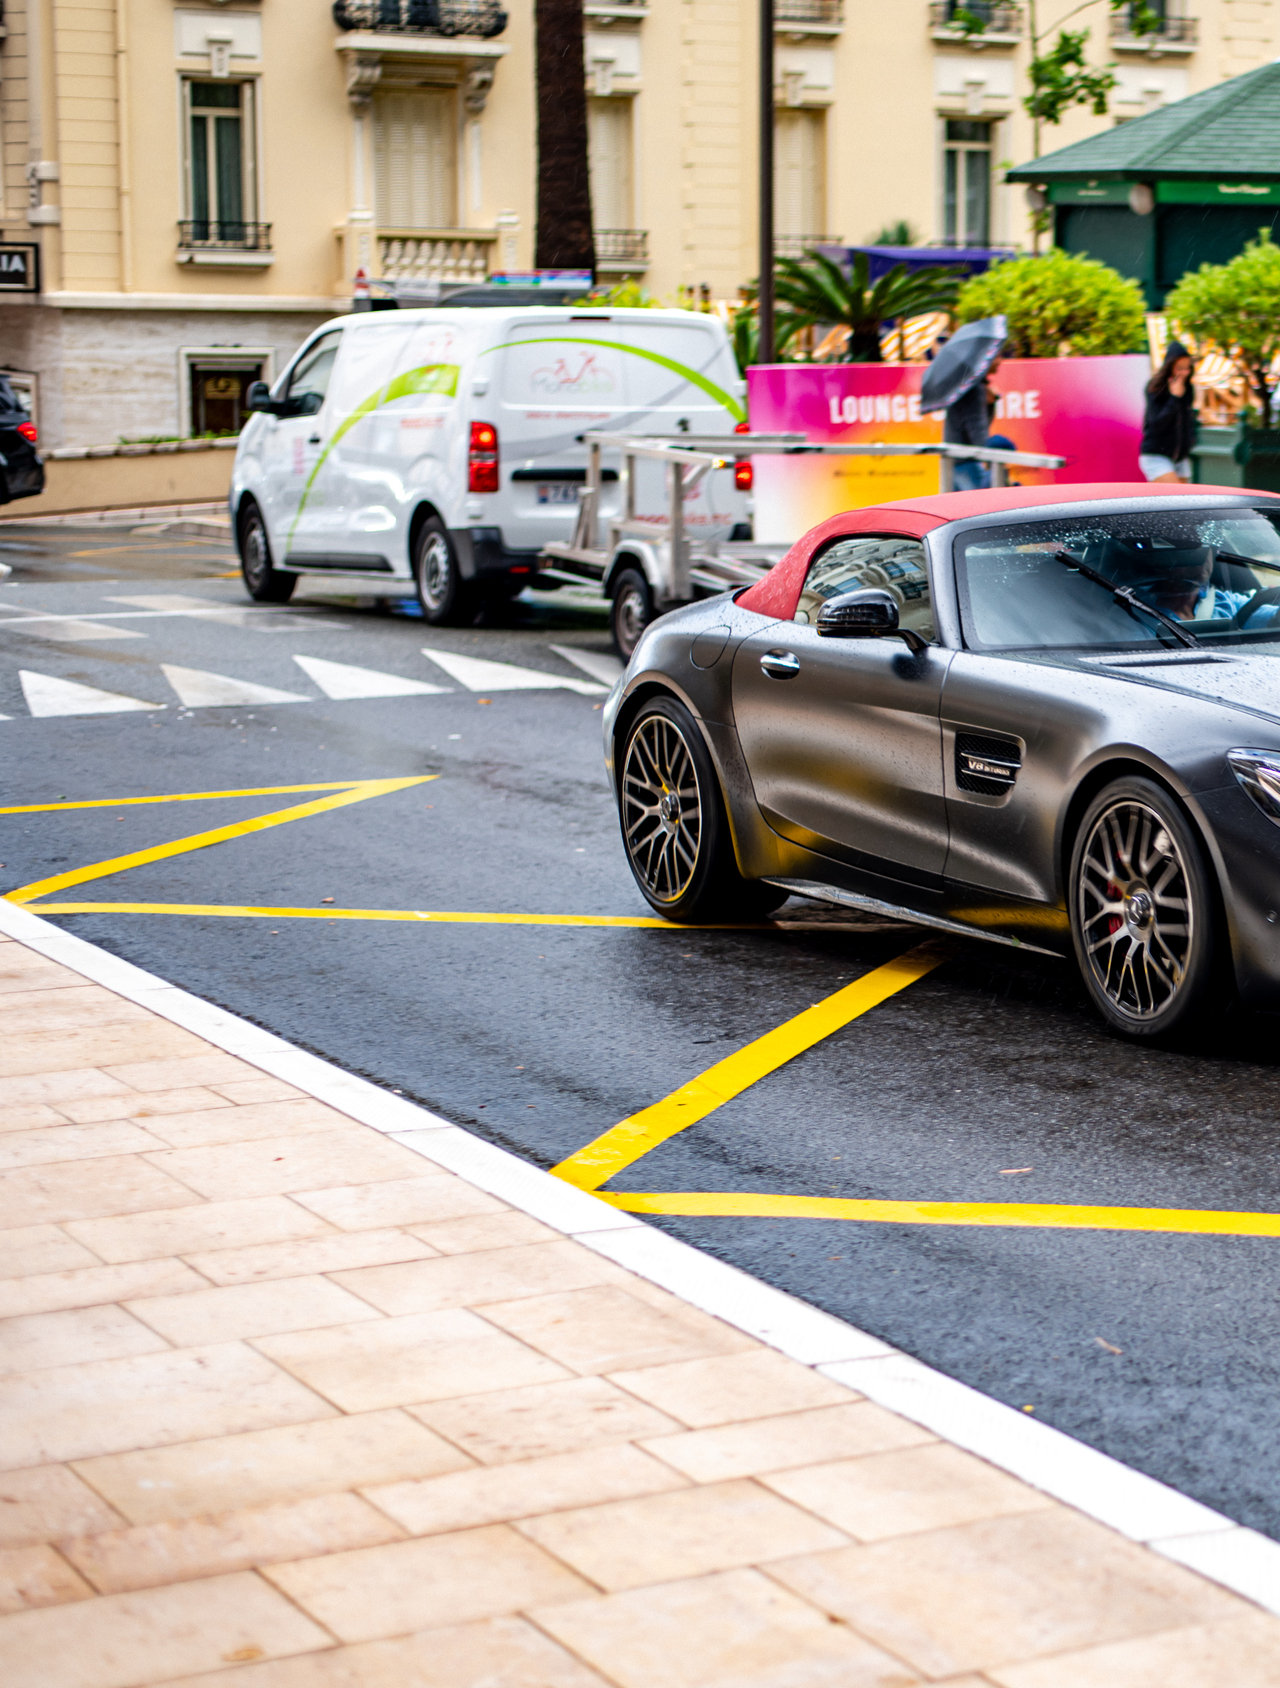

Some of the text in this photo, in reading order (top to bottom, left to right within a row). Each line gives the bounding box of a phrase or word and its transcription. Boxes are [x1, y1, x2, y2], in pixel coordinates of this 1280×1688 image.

[0, 254, 26, 272] IA
[829, 394, 924, 424] LOUNGE
[968, 760, 984, 770] V8
